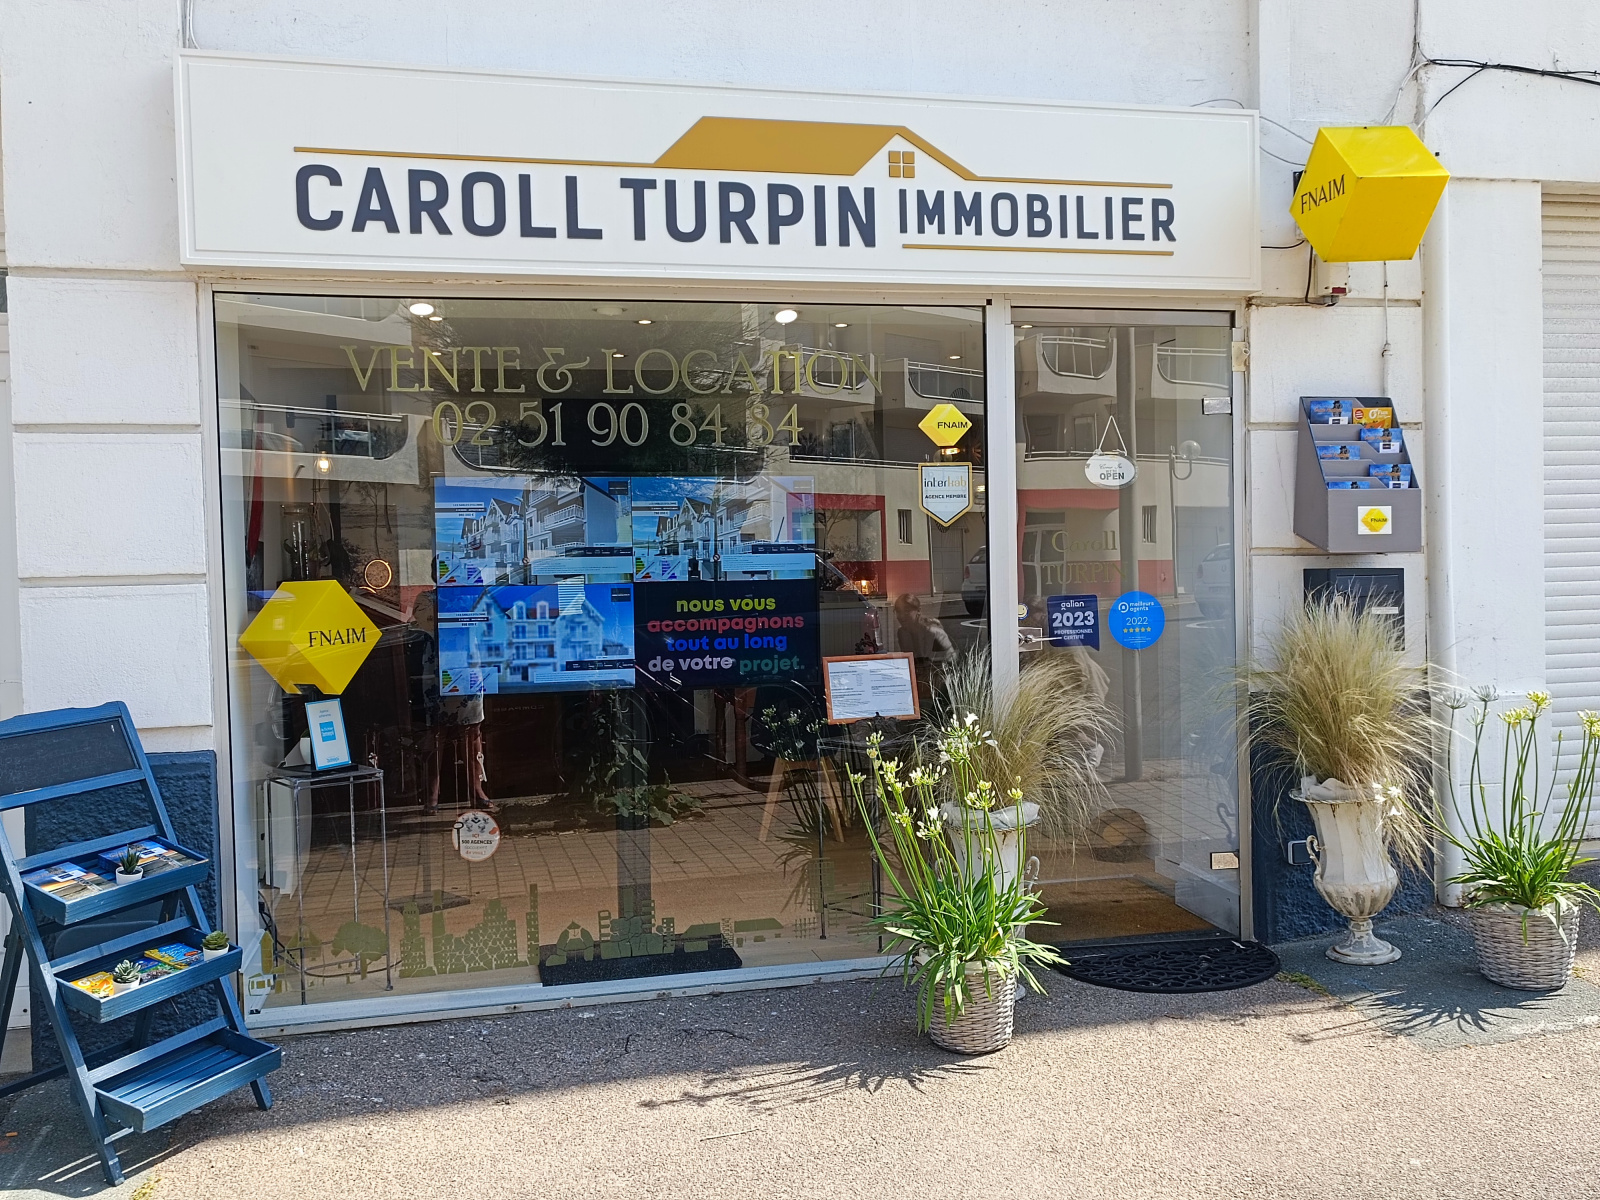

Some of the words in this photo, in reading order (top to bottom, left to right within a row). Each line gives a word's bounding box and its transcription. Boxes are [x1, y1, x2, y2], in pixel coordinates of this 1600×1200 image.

[1300, 173, 1347, 215] FNAIM
[295, 164, 603, 240] CAROLL
[619, 176, 876, 248] TURPIN
[898, 187, 1178, 243] IMMOBILIER
[340, 344, 526, 393] VENTE
[536, 346, 591, 394] &
[601, 347, 884, 395] LOCATION
[432, 400, 497, 447] 02
[518, 401, 567, 447] 51
[587, 401, 650, 447] 90
[669, 402, 728, 447] 84
[747, 402, 804, 447] 84
[937, 421, 969, 429] FNAIM
[1099, 472, 1125, 481] OPEN
[1051, 530, 1118, 553] Caroll
[1042, 561, 1129, 585] TURPIN
[676, 598, 725, 613] nous
[729, 597, 776, 611] vous
[1060, 599, 1085, 611] galian
[647, 615, 805, 634] accompagnons
[1052, 611, 1095, 628] 2023
[1125, 616, 1149, 626] 2022
[308, 627, 367, 648] FNAIM
[666, 635, 709, 652] tout
[713, 637, 739, 650] au
[744, 633, 787, 652] long
[648, 655, 675, 672] de
[678, 654, 733, 671] votre
[739, 655, 805, 674] projet.
